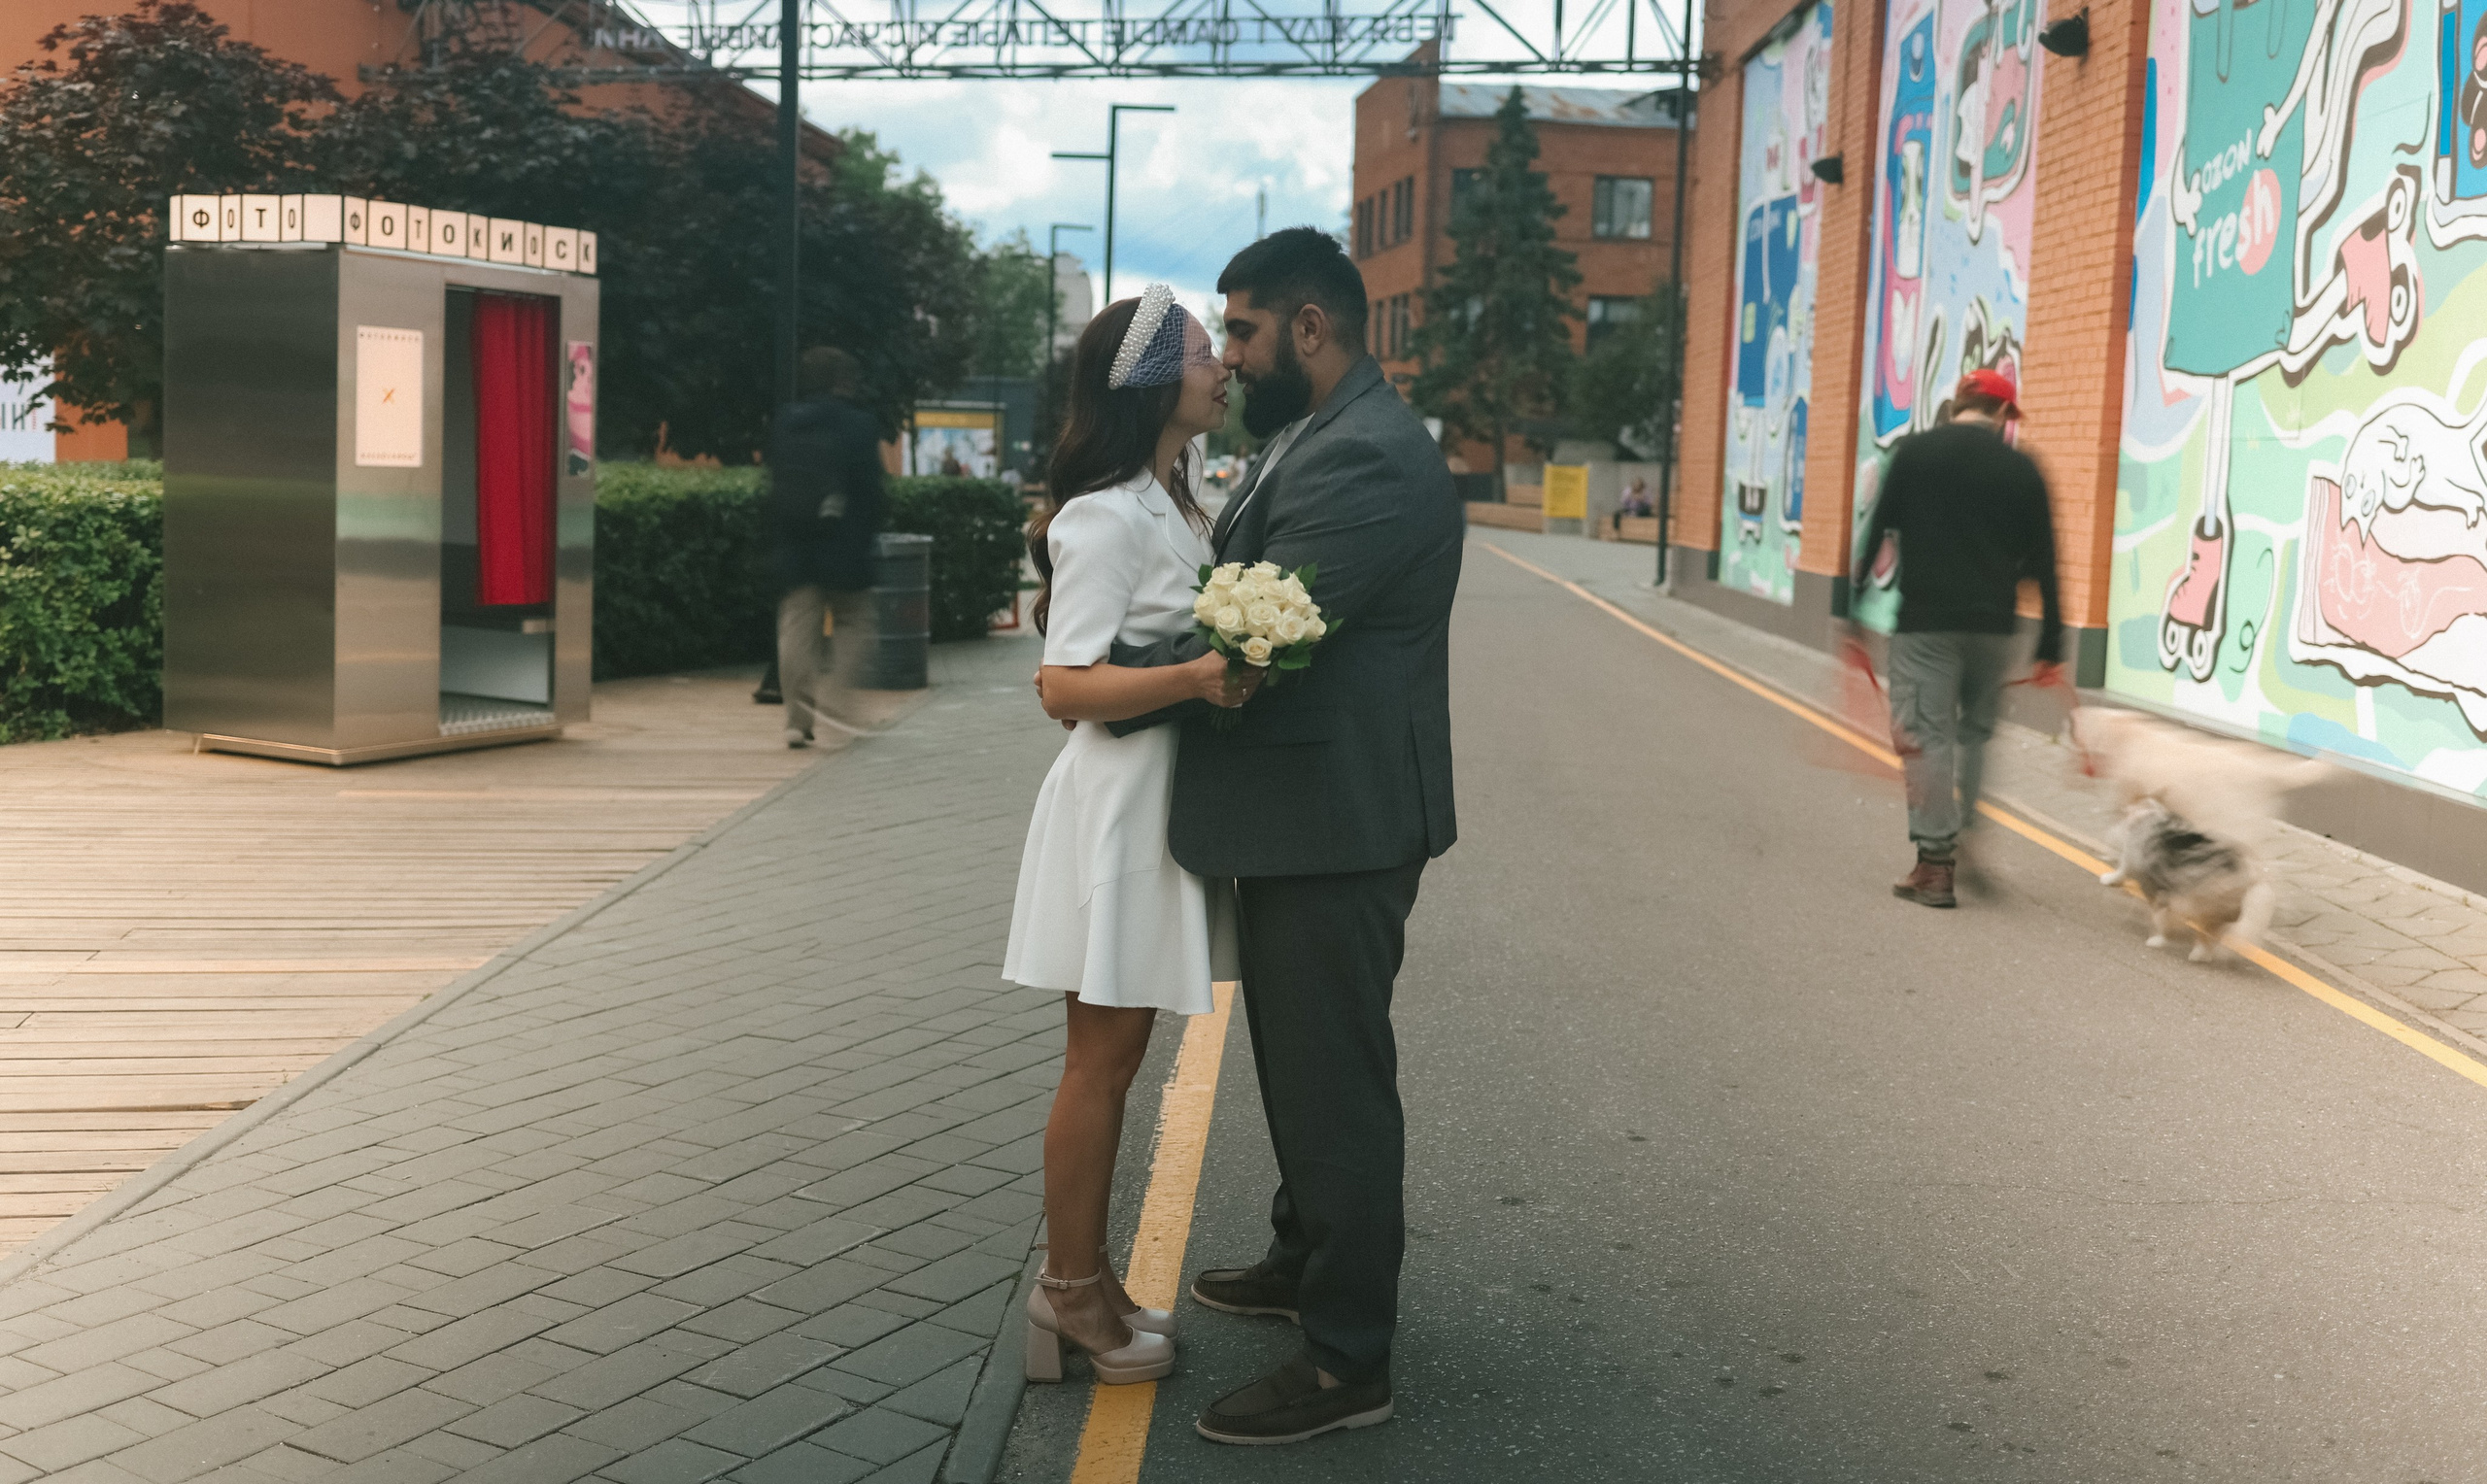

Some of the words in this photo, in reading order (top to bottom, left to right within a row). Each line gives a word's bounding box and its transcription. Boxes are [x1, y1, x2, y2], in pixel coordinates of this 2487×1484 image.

[2201, 127, 2253, 194] OZON
[192, 209, 296, 229] ФОТО
[349, 211, 591, 262] ФОТОКИОСК
[2193, 169, 2275, 289] fresh
